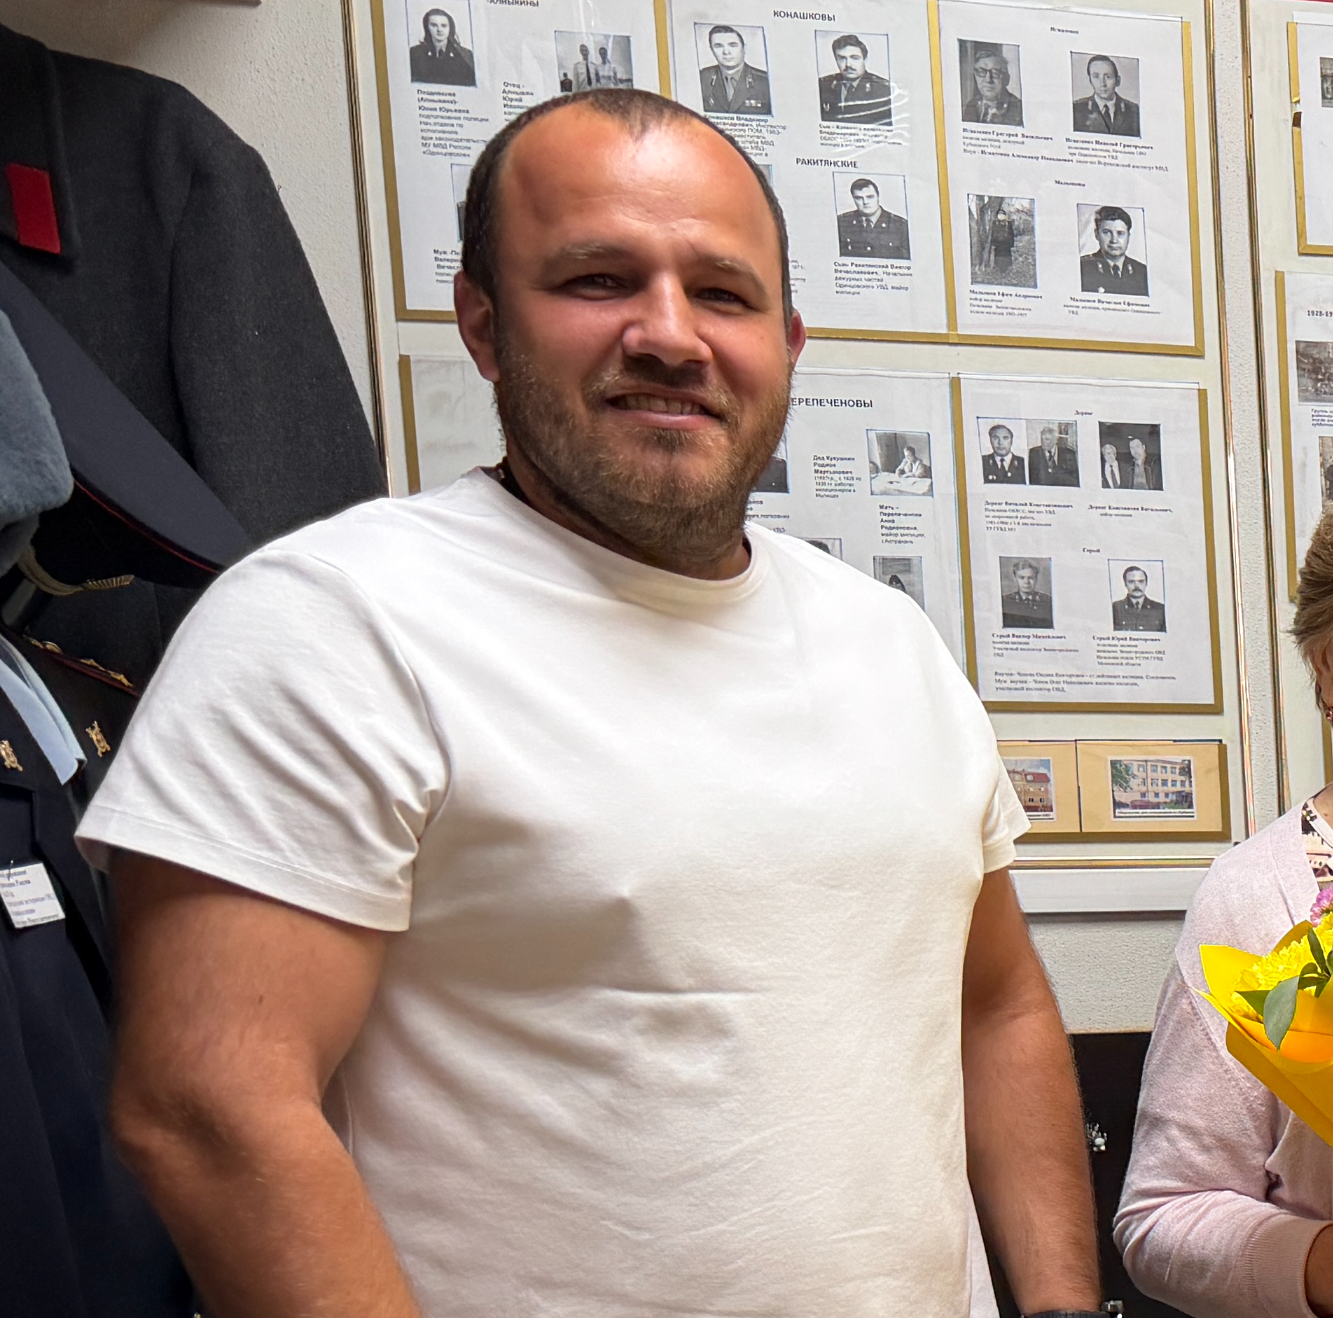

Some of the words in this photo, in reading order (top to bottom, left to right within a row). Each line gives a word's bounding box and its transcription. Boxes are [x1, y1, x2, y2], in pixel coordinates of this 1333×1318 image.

[773, 10, 836, 22] КОНАШКОВЫ
[796, 158, 858, 169] РАКИТЯНСКИЕ
[790, 397, 873, 408] ЕРЕПЕЧЕНОВЫ
